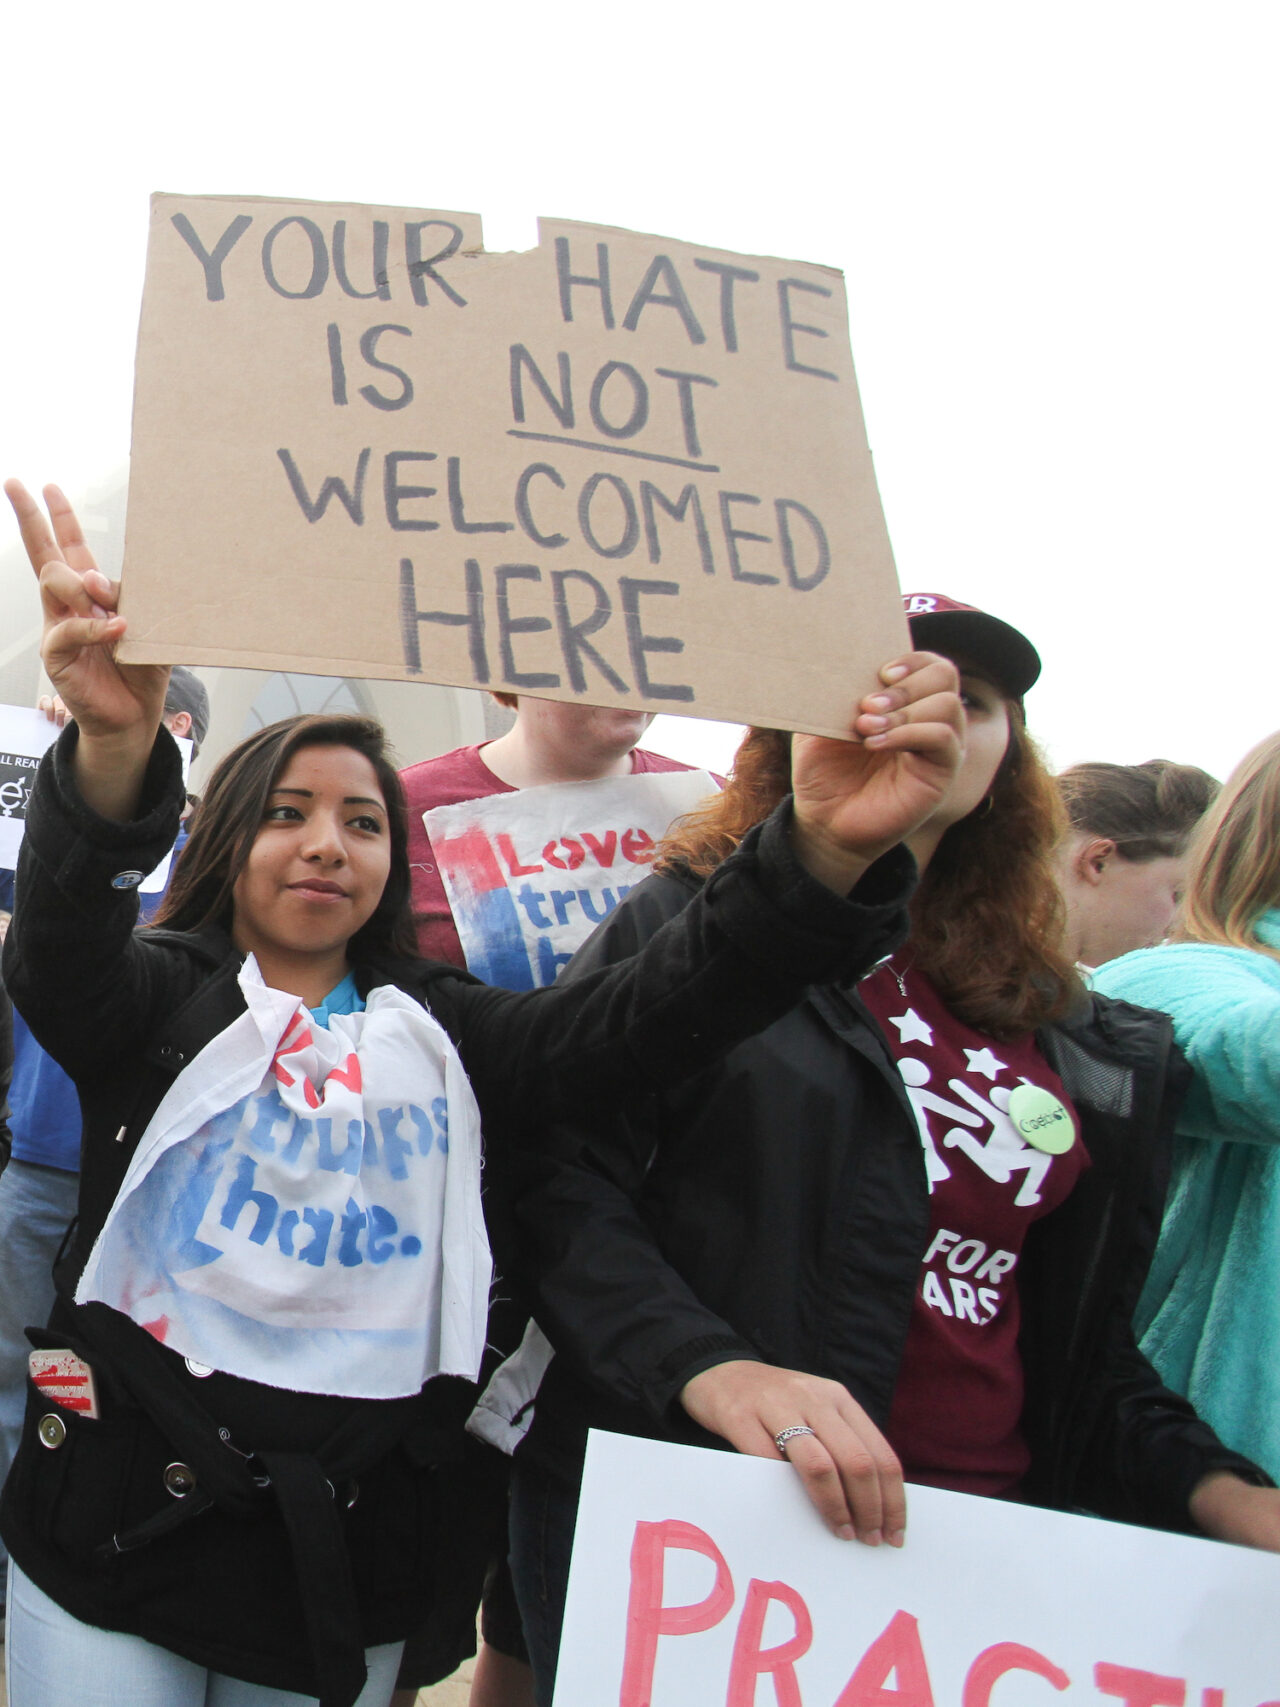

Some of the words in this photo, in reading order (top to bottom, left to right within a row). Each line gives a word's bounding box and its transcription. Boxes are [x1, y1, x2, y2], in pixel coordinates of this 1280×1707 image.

[170, 212, 468, 307] YOUR
[555, 236, 838, 381] HATE
[326, 322, 414, 411] IS
[509, 343, 719, 457] NOT
[276, 447, 832, 593] WELCOMED
[399, 557, 695, 702] HERE
[494, 828, 656, 877] Love
[517, 883, 638, 929] tru
[219, 1153, 423, 1268] hate.
[922, 1228, 1018, 1284] FOR
